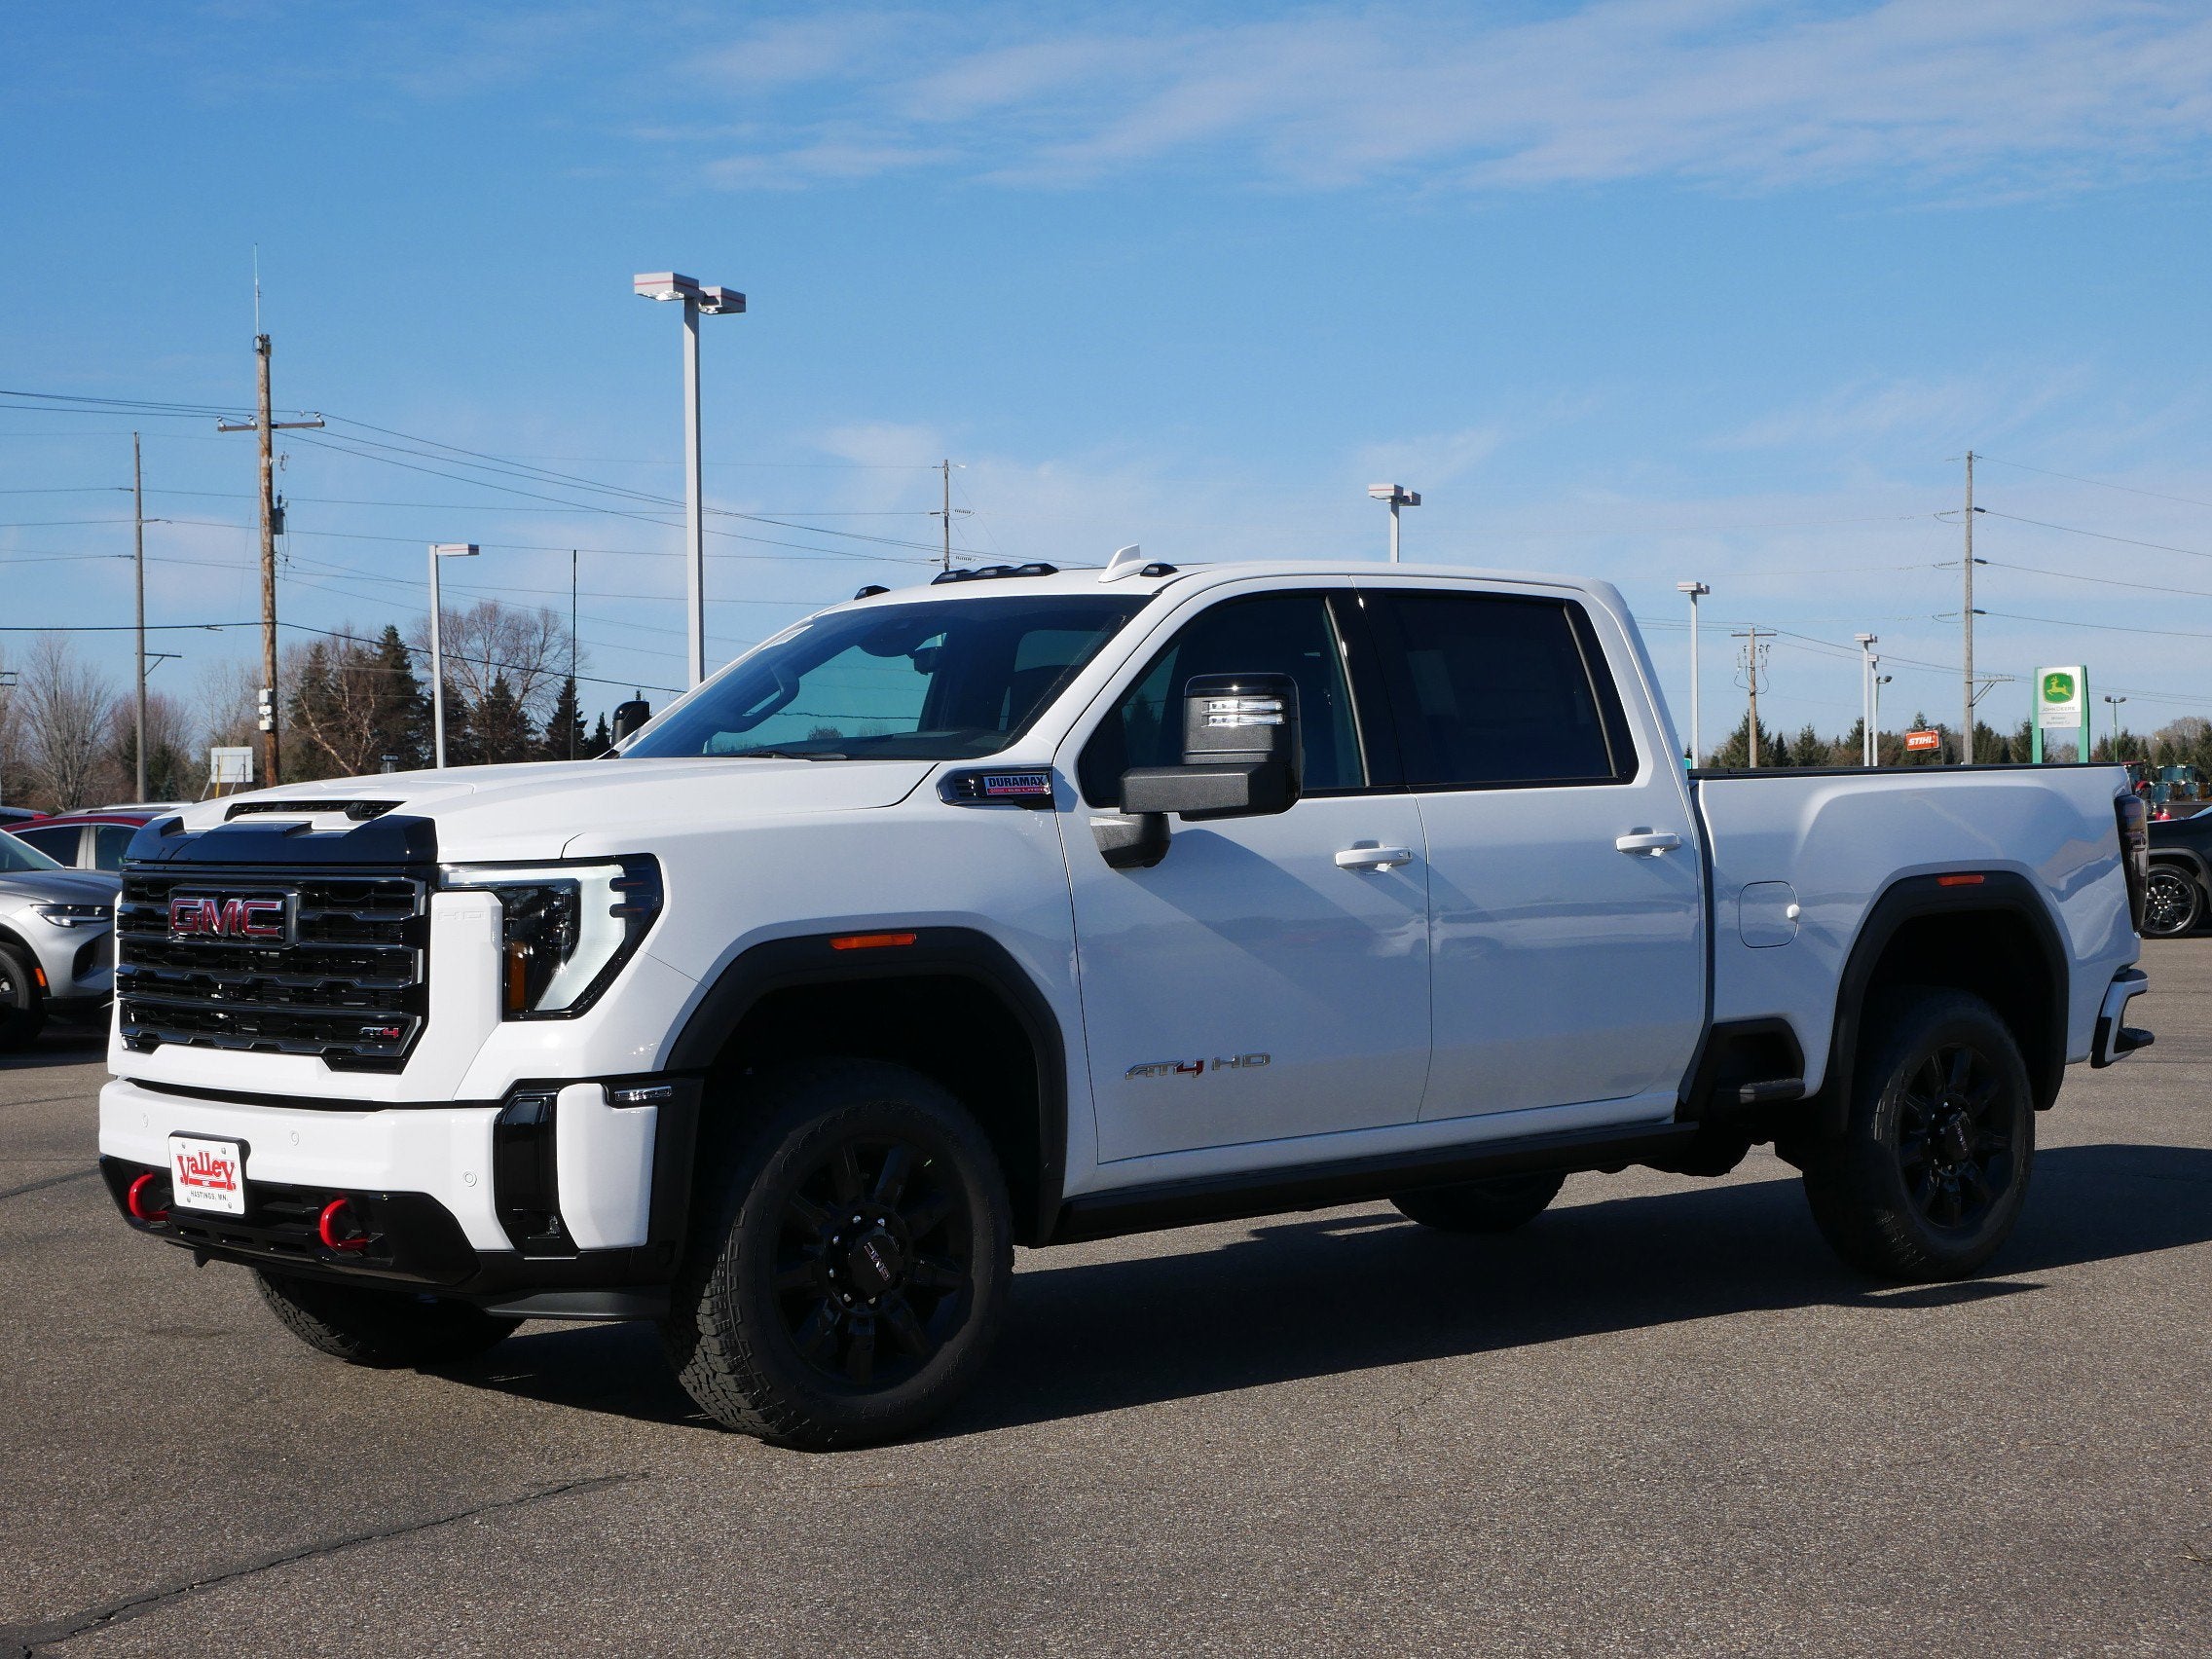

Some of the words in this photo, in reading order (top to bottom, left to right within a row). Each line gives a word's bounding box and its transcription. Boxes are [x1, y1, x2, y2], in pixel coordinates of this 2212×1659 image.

[1908, 735, 1935, 746] STIHL
[987, 777, 1045, 787] DURAMAX
[170, 897, 282, 937] GMC
[1124, 1059, 1205, 1080] AT4
[1212, 1051, 1272, 1071] HD
[176, 1151, 237, 1192] Valley
[864, 1241, 891, 1281] GMC
